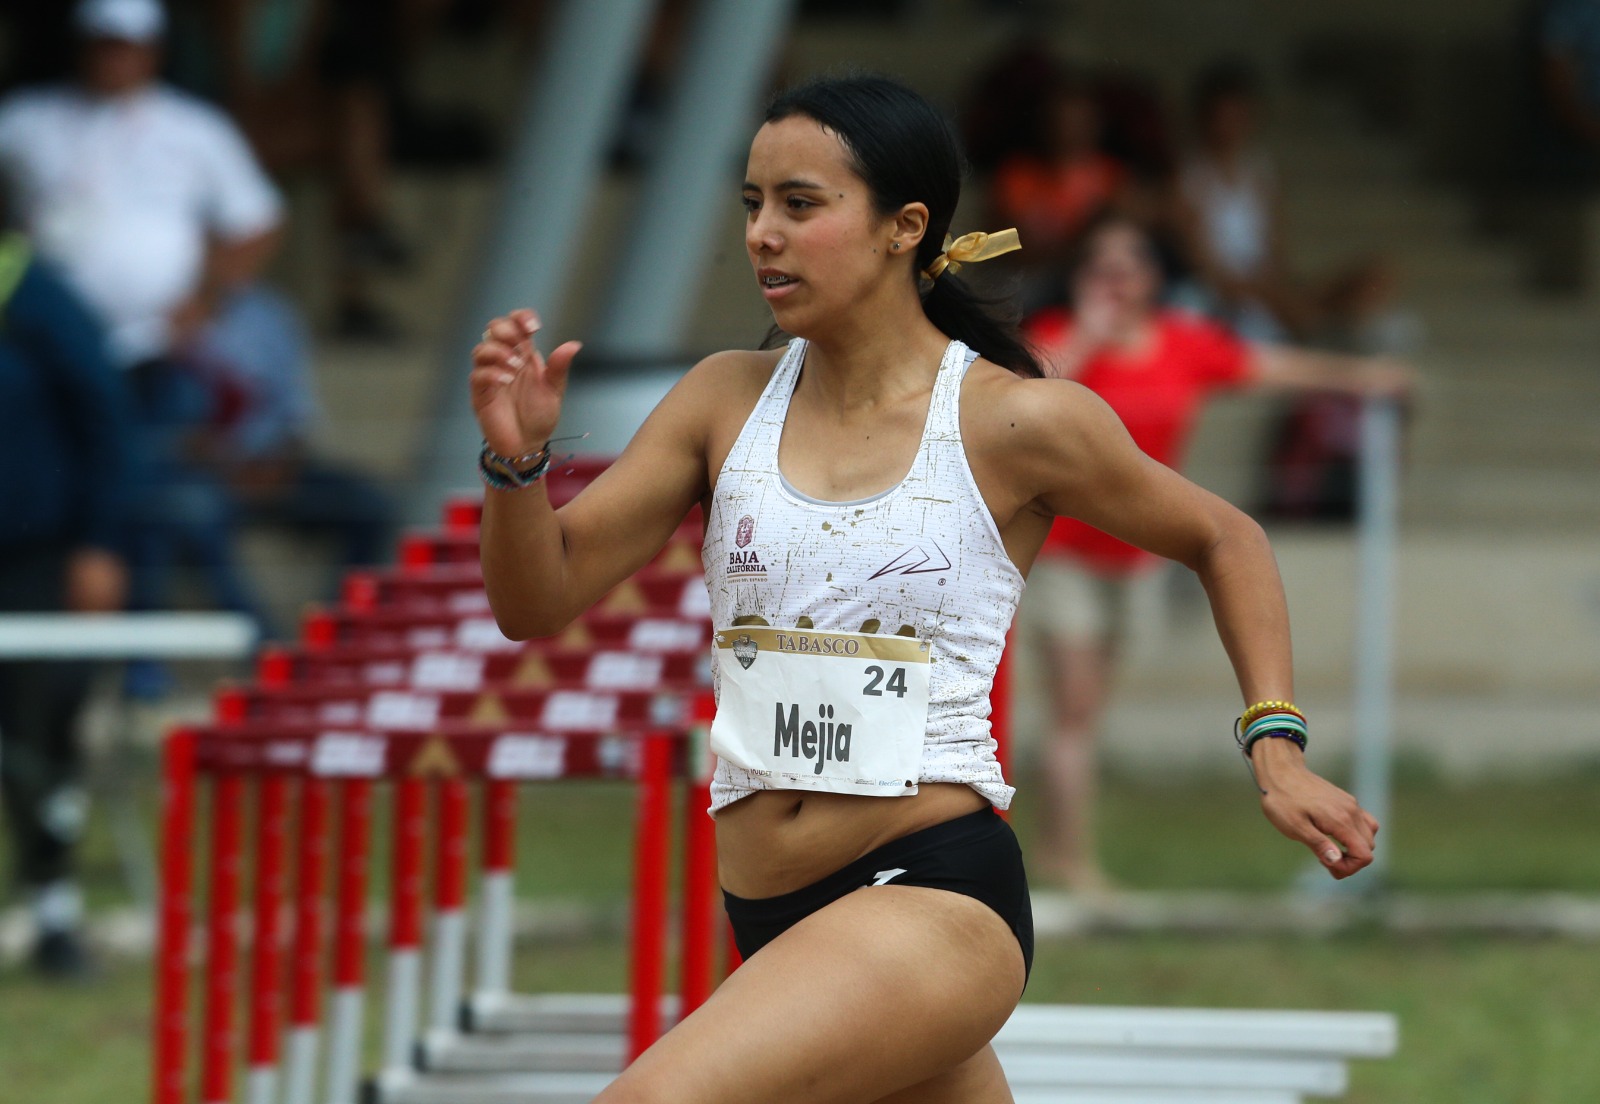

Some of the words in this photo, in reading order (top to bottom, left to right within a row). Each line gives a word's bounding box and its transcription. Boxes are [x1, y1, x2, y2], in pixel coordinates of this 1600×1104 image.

[730, 551, 759, 565] BAJA
[727, 564, 767, 573] CALIFORNIA
[776, 634, 860, 654] TABASCO
[863, 665, 908, 698] 24
[774, 702, 852, 775] Mejia
